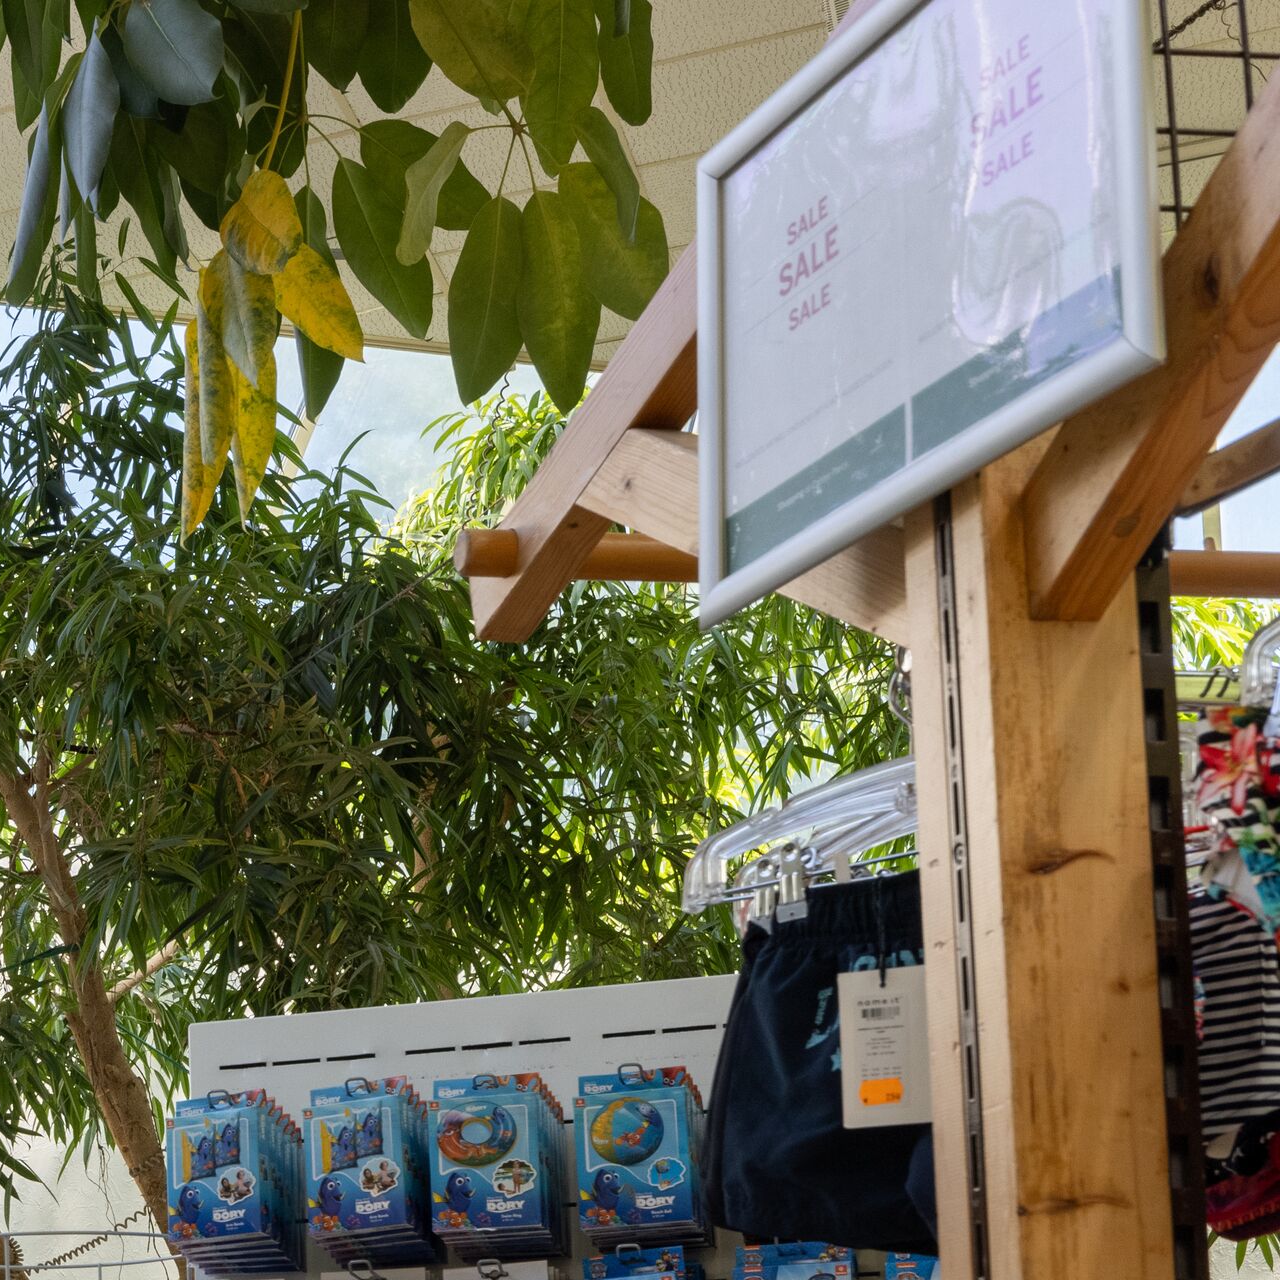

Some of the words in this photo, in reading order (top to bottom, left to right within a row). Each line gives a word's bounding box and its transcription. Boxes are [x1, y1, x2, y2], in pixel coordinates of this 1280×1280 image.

[980, 34, 1030, 90] SALE
[971, 66, 1044, 148] SALE
[982, 132, 1034, 187] SALE
[787, 195, 829, 245] SALE
[779, 224, 840, 297] SALE
[788, 283, 831, 331] SALE
[213, 1209, 246, 1220] DORY
[355, 1201, 390, 1212] DORY
[487, 1200, 525, 1211] DORY
[636, 1195, 676, 1207] DORY
